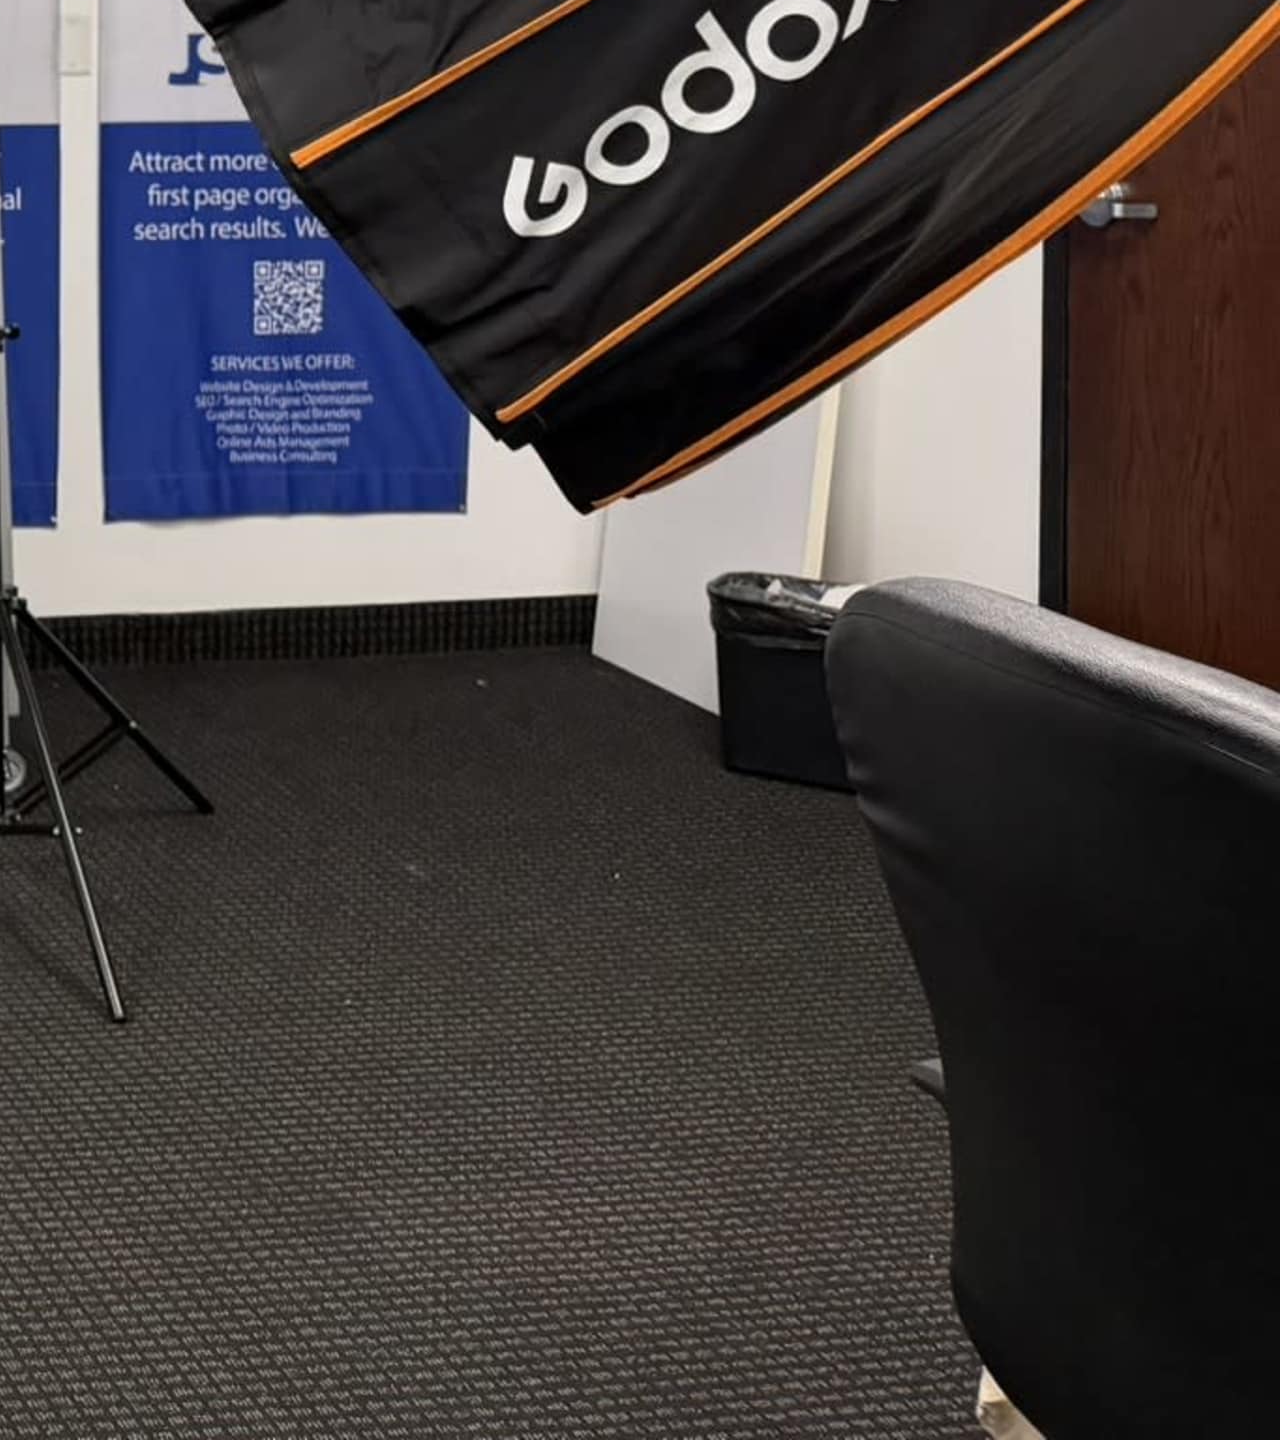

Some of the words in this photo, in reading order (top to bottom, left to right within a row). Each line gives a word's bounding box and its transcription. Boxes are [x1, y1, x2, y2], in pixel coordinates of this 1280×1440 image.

[128, 150, 204, 173] Attract
[209, 154, 267, 172] more
[147, 183, 190, 206] first
[194, 188, 251, 210] page
[133, 217, 204, 240] search
[210, 216, 286, 239] results.
[211, 355, 280, 372] SERVICES
[281, 355, 303, 371] WE
[305, 354, 356, 370] OFFER:
[200, 380, 241, 393] Website
[243, 380, 284, 394] Design
[296, 379, 368, 393] Development
[195, 395, 215, 408] SEO
[224, 394, 261, 406] Search
[264, 394, 301, 408] Engine
[302, 393, 374, 407] Optimization
[206, 409, 246, 422] Graphic
[248, 409, 289, 422] Design
[290, 409, 310, 420] and
[312, 408, 363, 422] Branding
[216, 423, 248, 434] Photo
[256, 423, 290, 434] Video
[292, 422, 351, 434] Production
[216, 437, 252, 449] Online
[254, 437, 277, 448] Ads
[278, 436, 350, 450] Management
[229, 450, 278, 464] Business
[279, 450, 337, 465] Consulting
